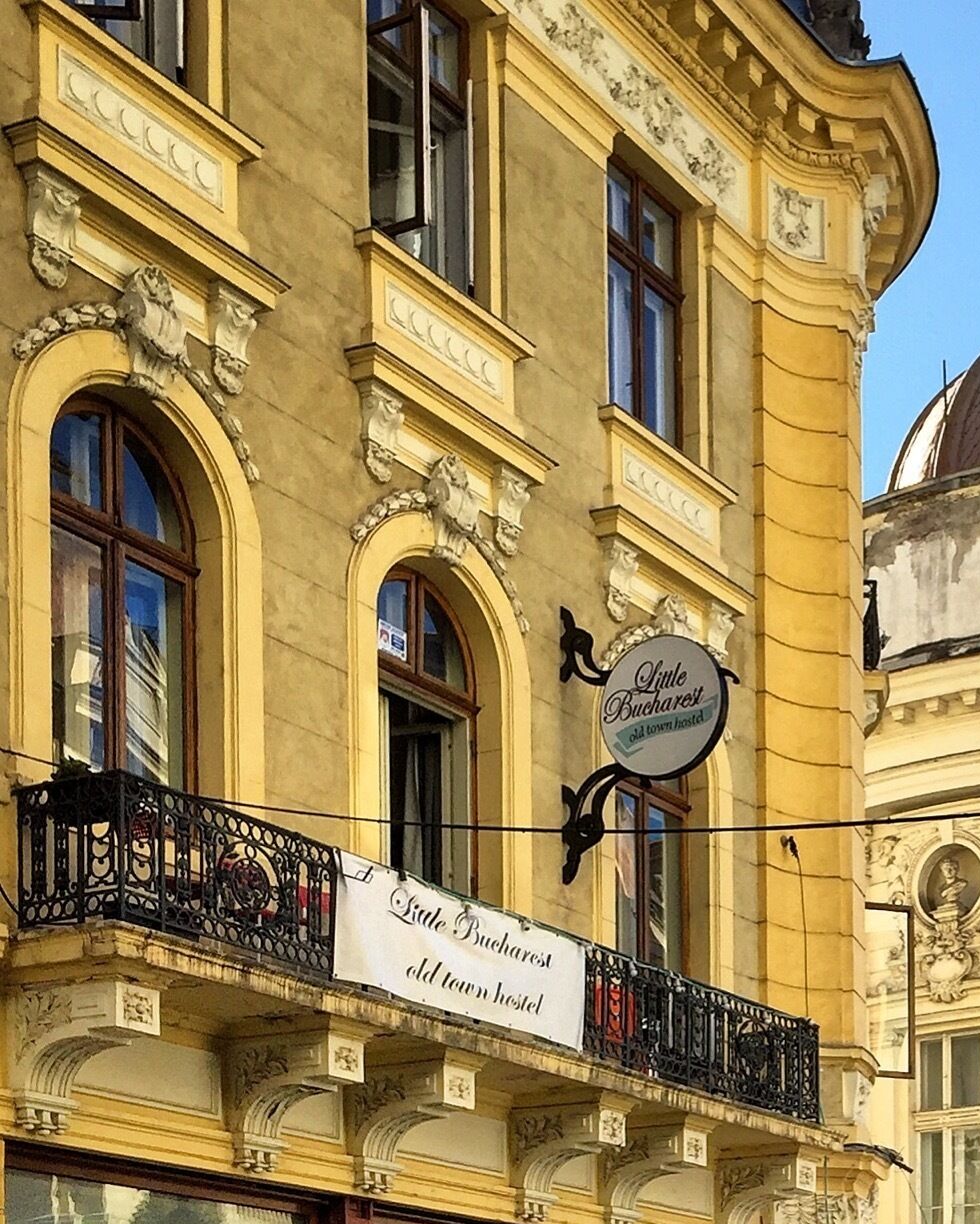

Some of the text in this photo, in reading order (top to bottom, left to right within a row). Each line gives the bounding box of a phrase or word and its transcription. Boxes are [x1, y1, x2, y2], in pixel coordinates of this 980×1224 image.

[633, 660, 688, 694] Little
[603, 686, 704, 724] Bucharest
[629, 710, 705, 743] old town hostel
[387, 887, 553, 969] Little Bucharest
[406, 958, 544, 1016] old town hostel
